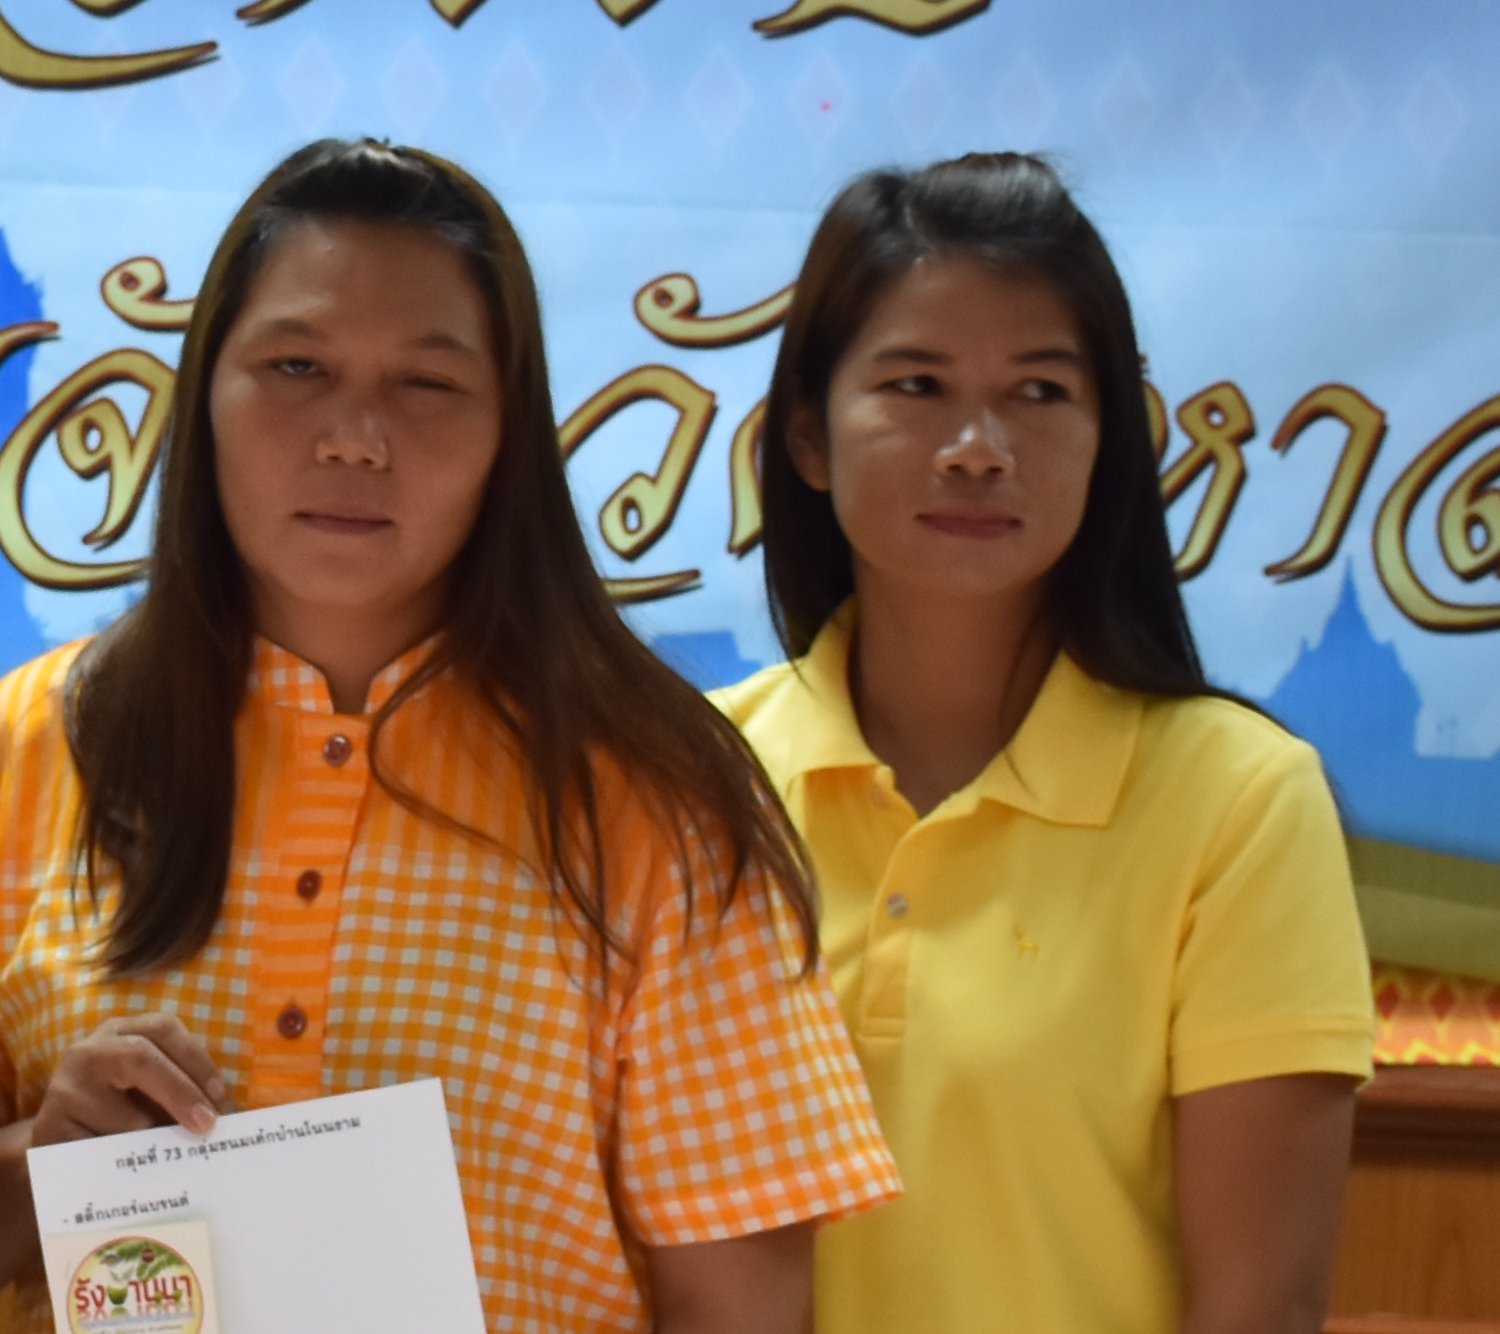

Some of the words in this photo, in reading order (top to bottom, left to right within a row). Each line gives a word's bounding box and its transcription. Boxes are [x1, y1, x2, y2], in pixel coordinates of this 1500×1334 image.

[116, 1144, 158, 1173] กลุ่มที่
[162, 1147, 182, 1163] 73
